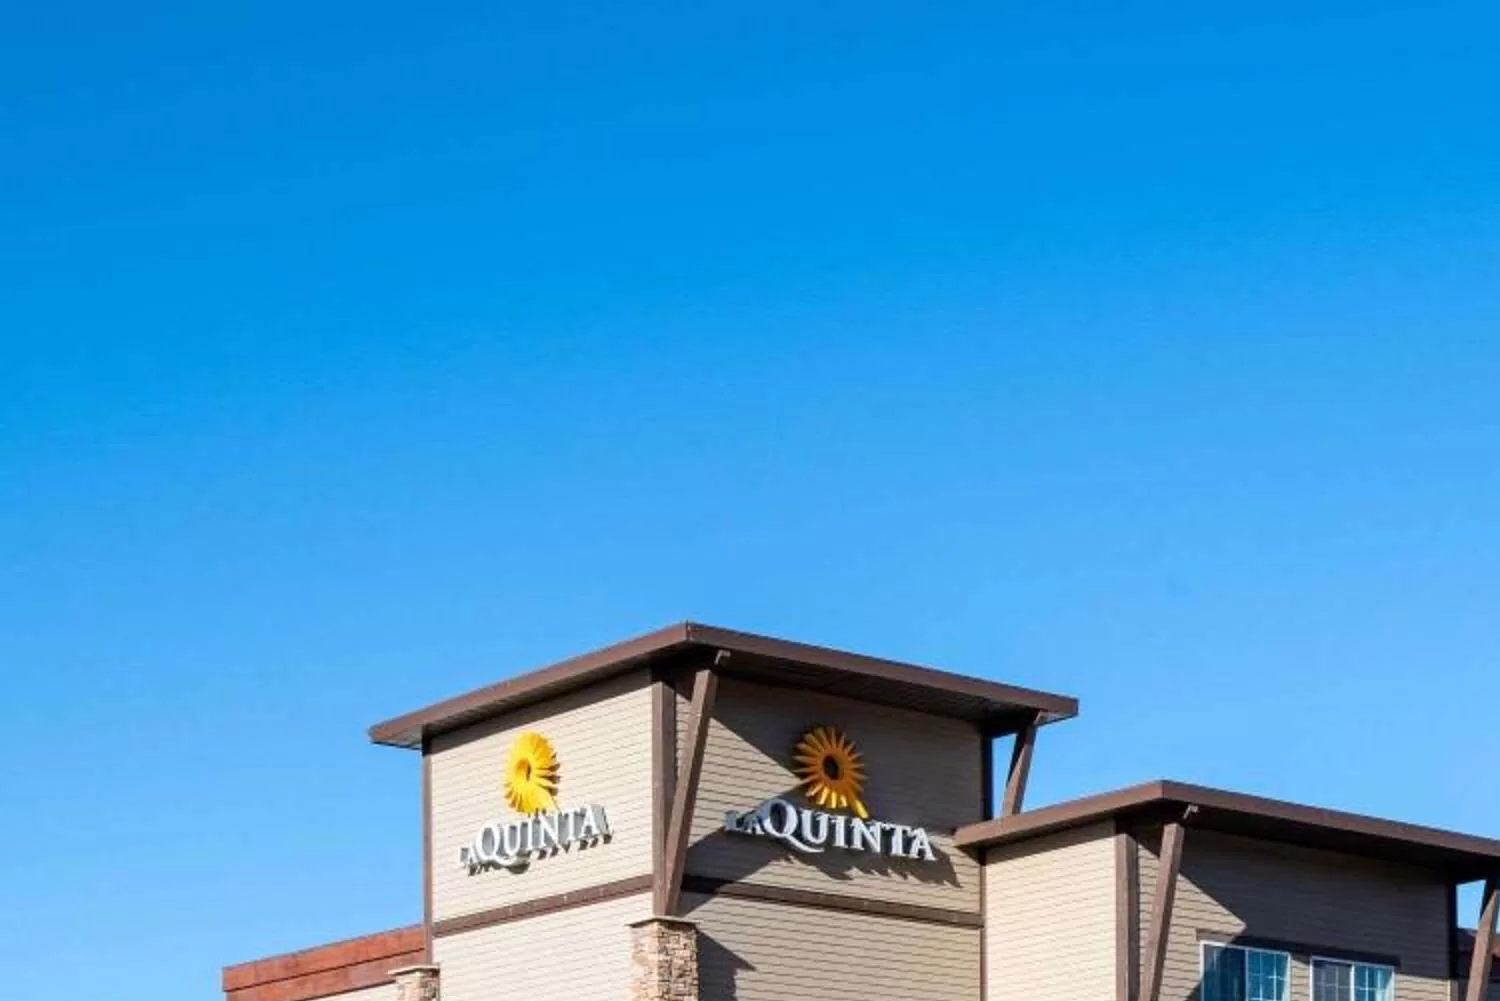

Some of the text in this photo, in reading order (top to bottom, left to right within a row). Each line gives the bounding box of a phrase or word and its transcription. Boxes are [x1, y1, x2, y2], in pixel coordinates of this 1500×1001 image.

[475, 803, 607, 866] QUINTA
[725, 799, 936, 861] LA QUINTA
